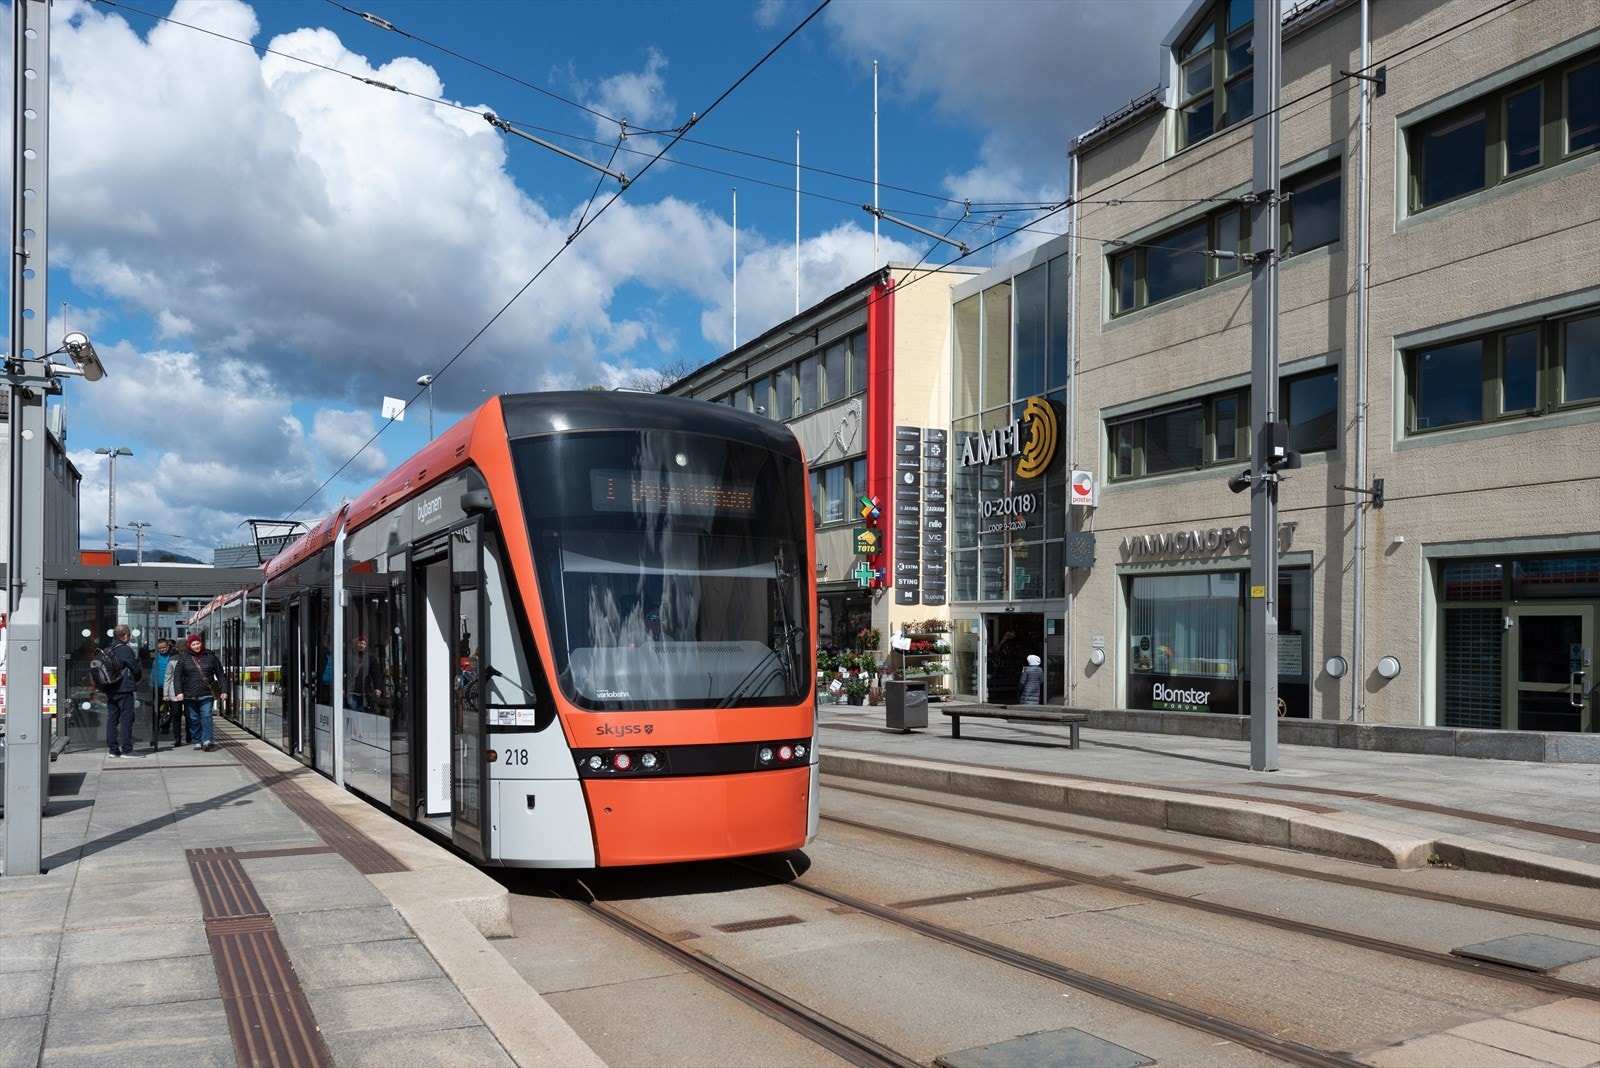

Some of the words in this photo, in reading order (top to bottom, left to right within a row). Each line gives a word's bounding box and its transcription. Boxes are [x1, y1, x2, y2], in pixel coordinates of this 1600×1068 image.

[960, 418, 1021, 468] AMFI
[417, 496, 442, 523] bybanen
[979, 493, 1037, 518] 10-20(18)
[928, 520, 943, 528] nille
[1123, 521, 1298, 557] VINMONOPOT
[1152, 682, 1211, 705] Blomster
[1163, 703, 1199, 711] FORUM
[595, 723, 642, 738] skyss
[505, 749, 529, 766] 218
